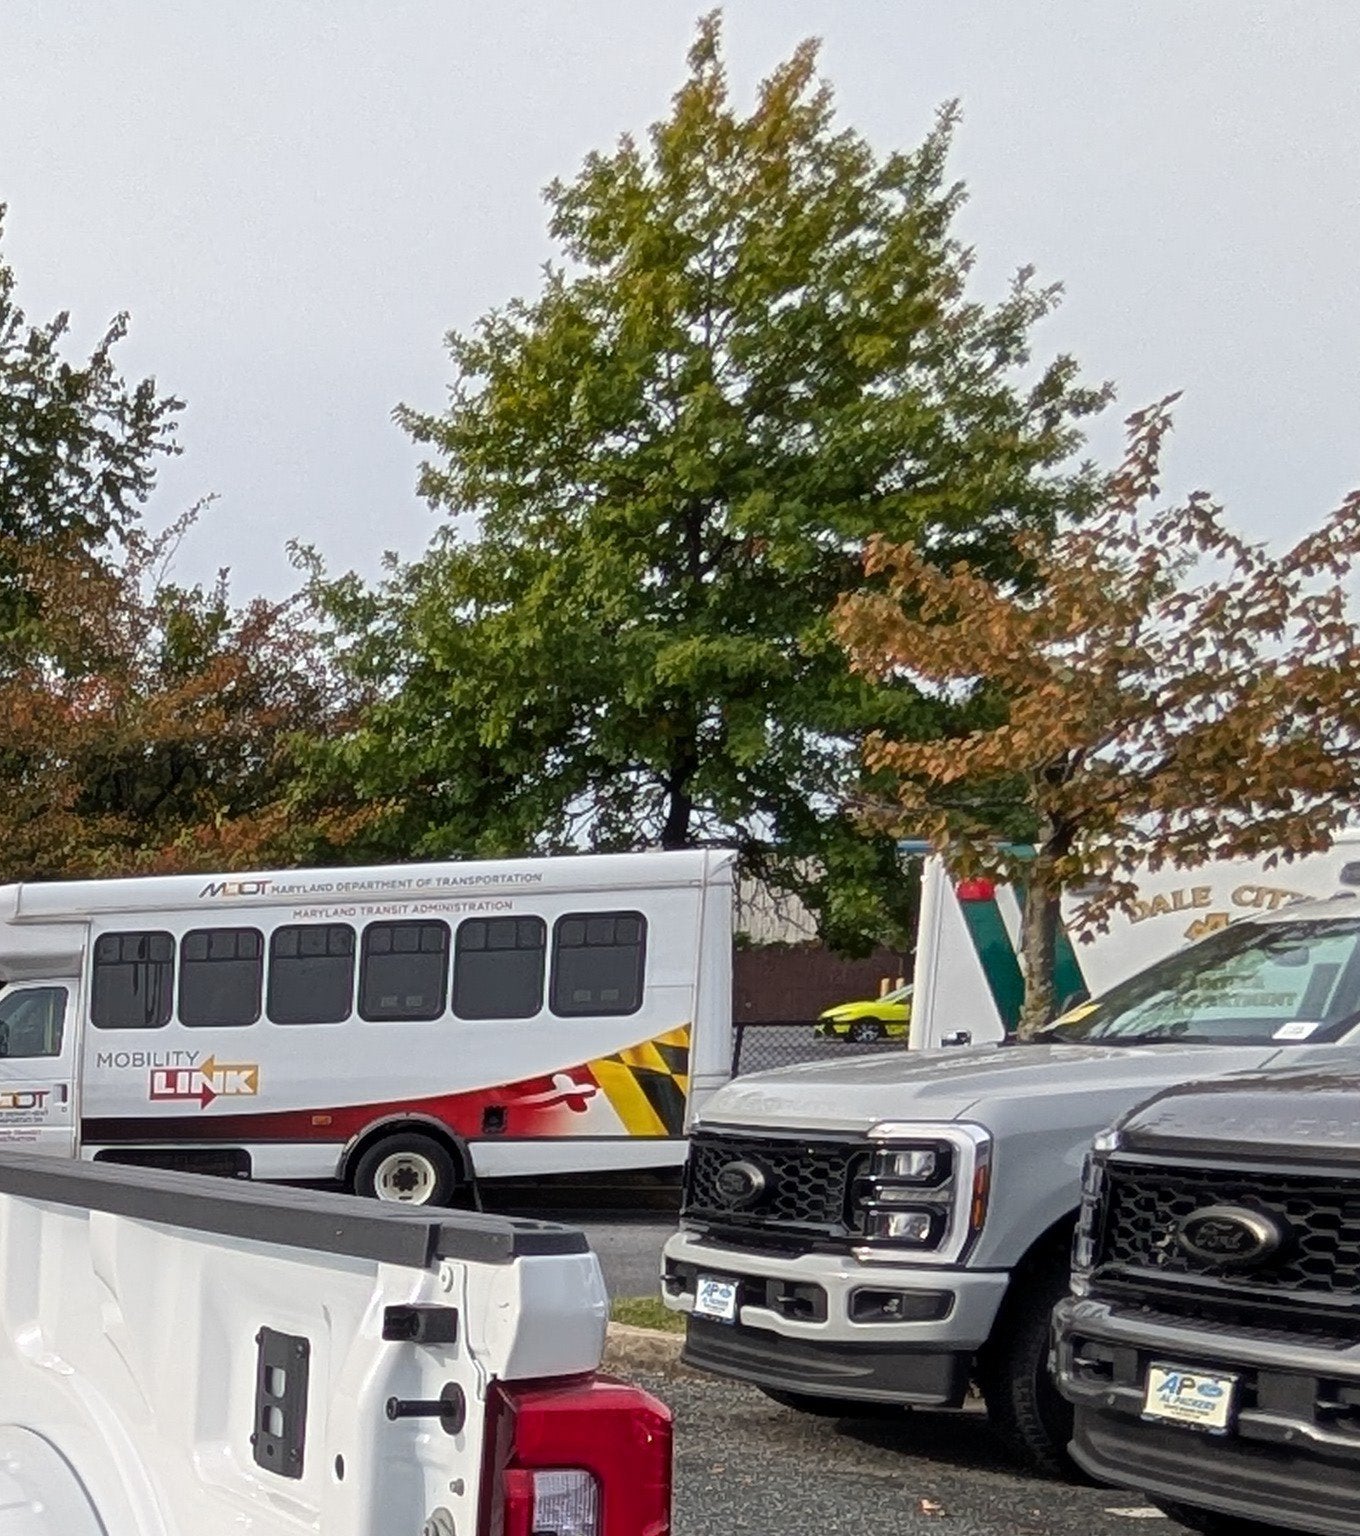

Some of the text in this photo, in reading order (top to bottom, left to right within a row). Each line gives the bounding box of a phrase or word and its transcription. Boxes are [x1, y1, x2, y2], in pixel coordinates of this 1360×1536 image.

[272, 883, 333, 895] MARYLAND
[336, 878, 413, 892] DEPARTMENT
[416, 878, 431, 888] OF
[436, 873, 543, 887] TRANSPORTATION
[292, 901, 514, 919] MARYLAND TRANSIT ADMINISTRATION
[96, 1051, 200, 1069] MOBILITY
[153, 1070, 256, 1095] LINK
[1156, 1375, 1196, 1395] AP
